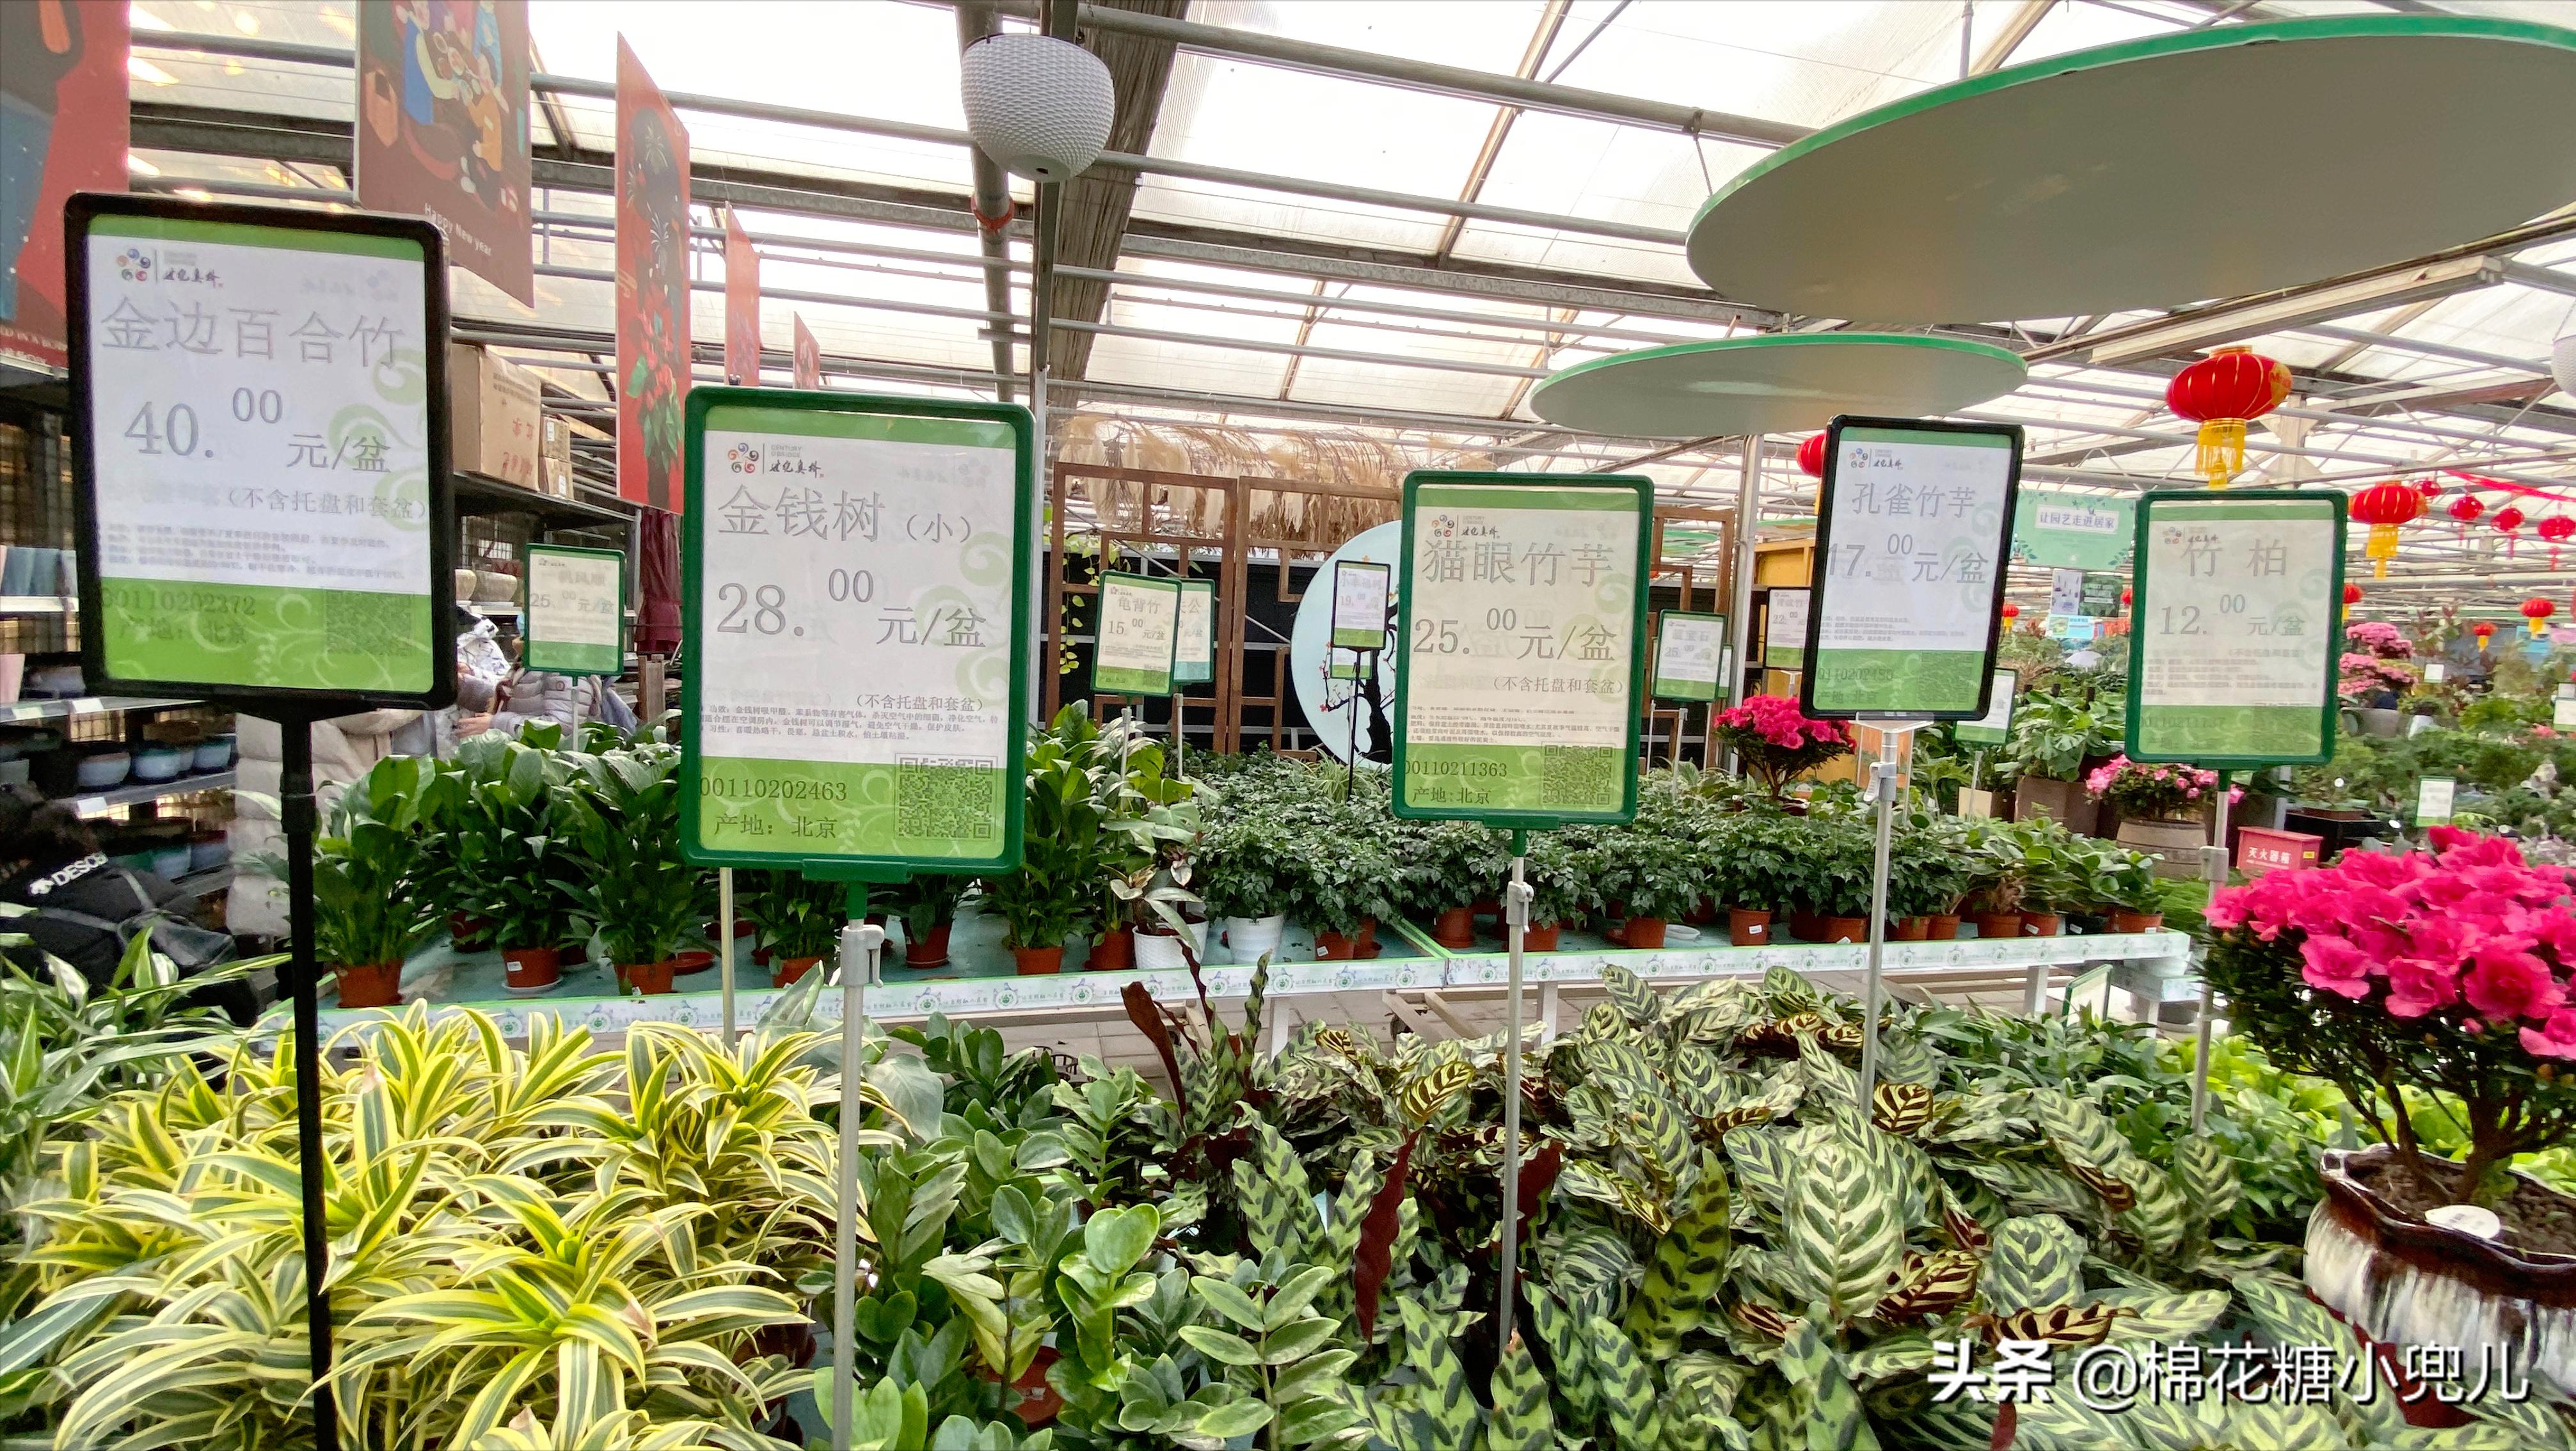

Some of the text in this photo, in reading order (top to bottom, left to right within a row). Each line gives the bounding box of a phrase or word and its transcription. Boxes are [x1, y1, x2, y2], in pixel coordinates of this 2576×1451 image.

[424, 202, 453, 234] Happy
[456, 223, 472, 244] New
[101, 295, 407, 369] 金边百合竹
[1852, 482, 1976, 519] 孔雀竹芋
[2040, 512, 2115, 529] 让园艺走进居家
[1422, 539, 1614, 587] 猫眼竹芋
[1118, 596, 1161, 615] 龟背竹
[1492, 676, 1625, 695] (不含托盘和套盆)
[855, 693, 986, 713] (不含托盘和套盆)
[2248, 846, 2291, 864] 灭火器箱
